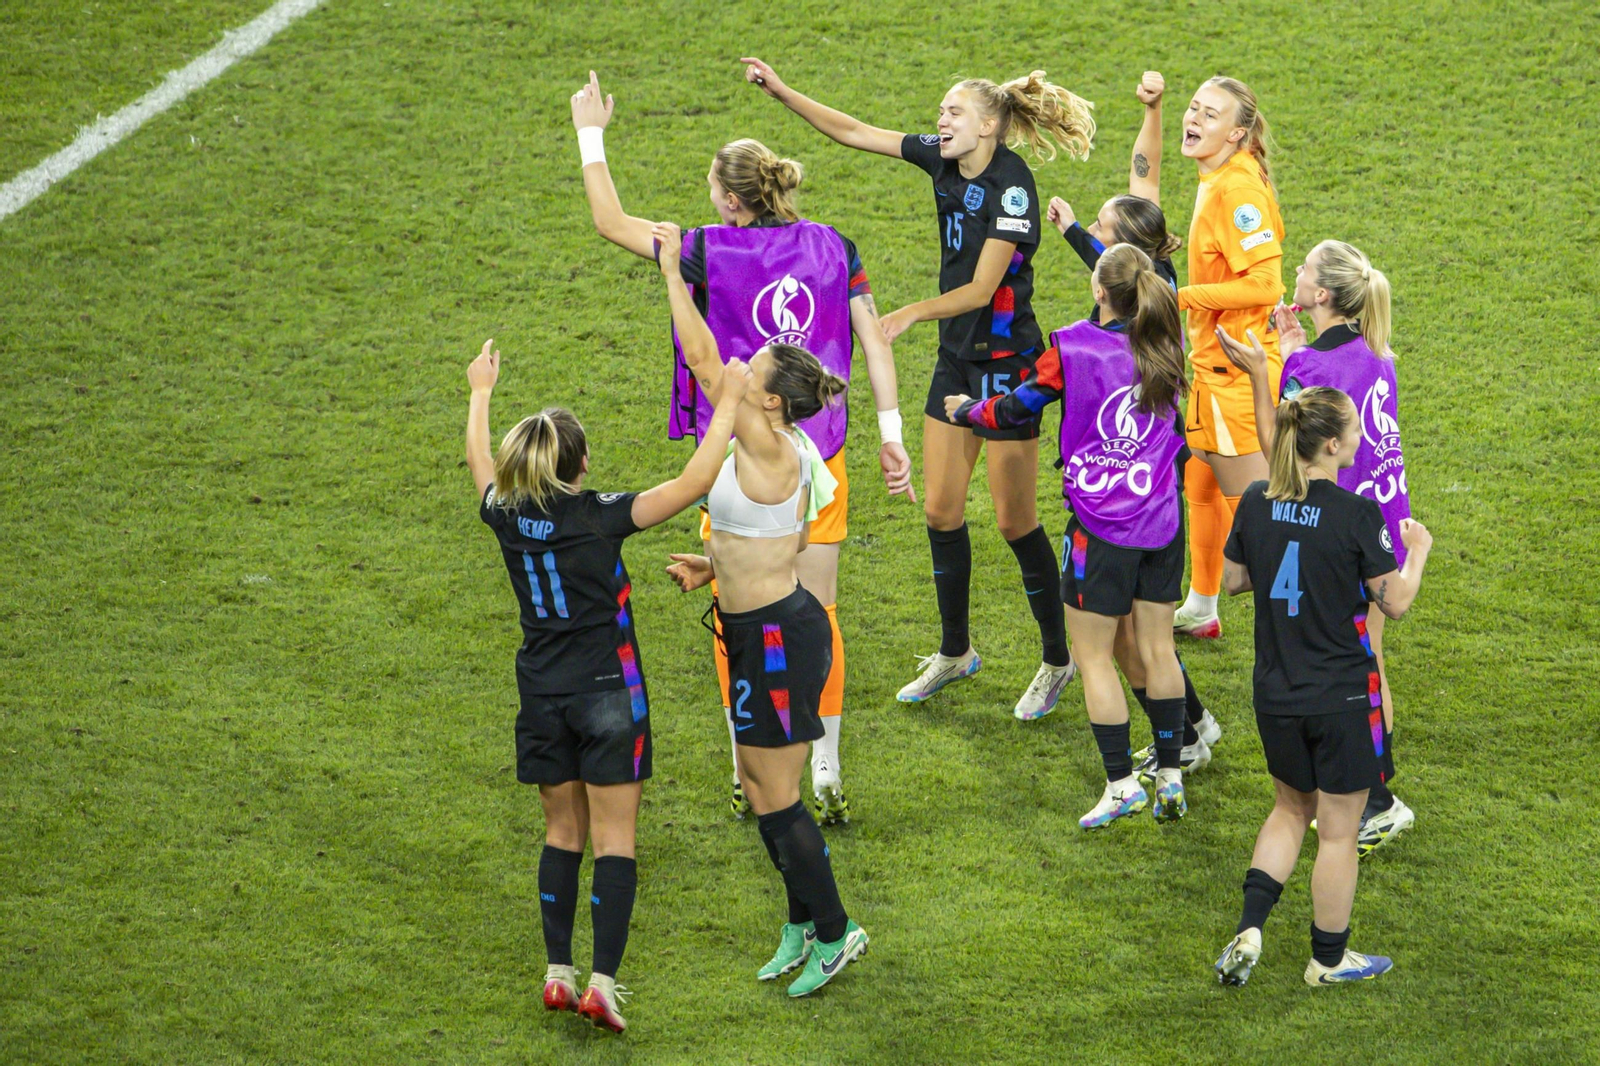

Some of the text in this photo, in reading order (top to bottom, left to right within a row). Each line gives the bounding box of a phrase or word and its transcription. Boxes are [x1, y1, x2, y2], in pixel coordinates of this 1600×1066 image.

[946, 212, 964, 251] 15
[982, 373, 1011, 400] 15
[1102, 441, 1136, 457] UEFA
[1370, 455, 1404, 479] wome
[1271, 500, 1321, 528] WALSH
[517, 516, 554, 541] HEMP
[522, 549, 569, 618] 11
[1269, 541, 1304, 617] 4
[736, 679, 752, 719] 2
